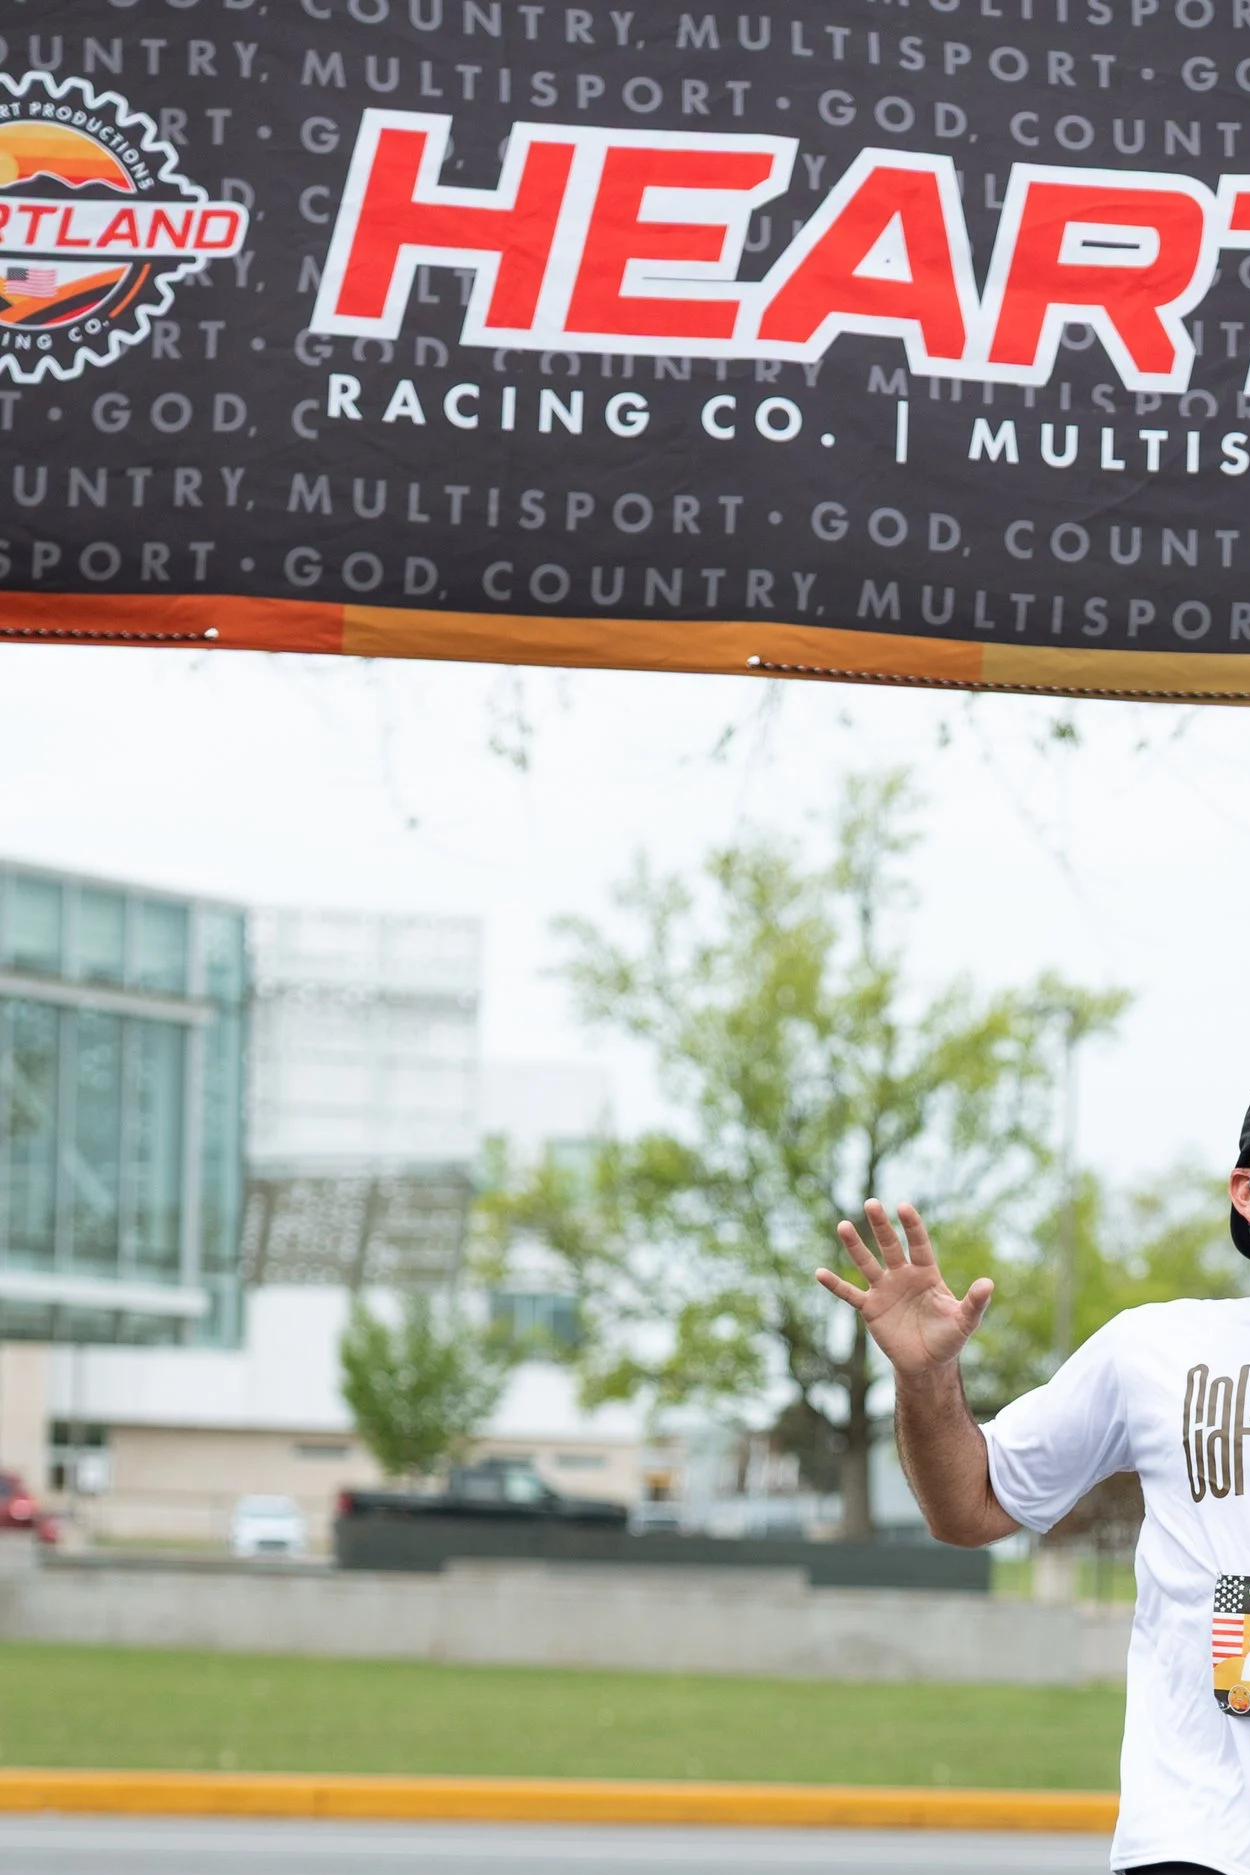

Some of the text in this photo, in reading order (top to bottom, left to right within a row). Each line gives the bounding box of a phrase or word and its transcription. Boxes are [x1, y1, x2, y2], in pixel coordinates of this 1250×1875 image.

[0, 34, 269, 83] UNTRY,
[300, 49, 752, 117] MULTISPORT
[818, 89, 979, 143] GOD,
[676, 14, 1116, 88] MULTISPORT
[29, 102, 155, 191] PRODUCTIONS
[92, 392, 258, 437] GOD,
[327, 372, 651, 438] RACING
[701, 394, 836, 448] CO.
[288, 473, 744, 535] MULTISPORT
[811, 501, 971, 557] GOD,
[283, 546, 446, 600] GOD,
[482, 561, 825, 616] COUNTRY,
